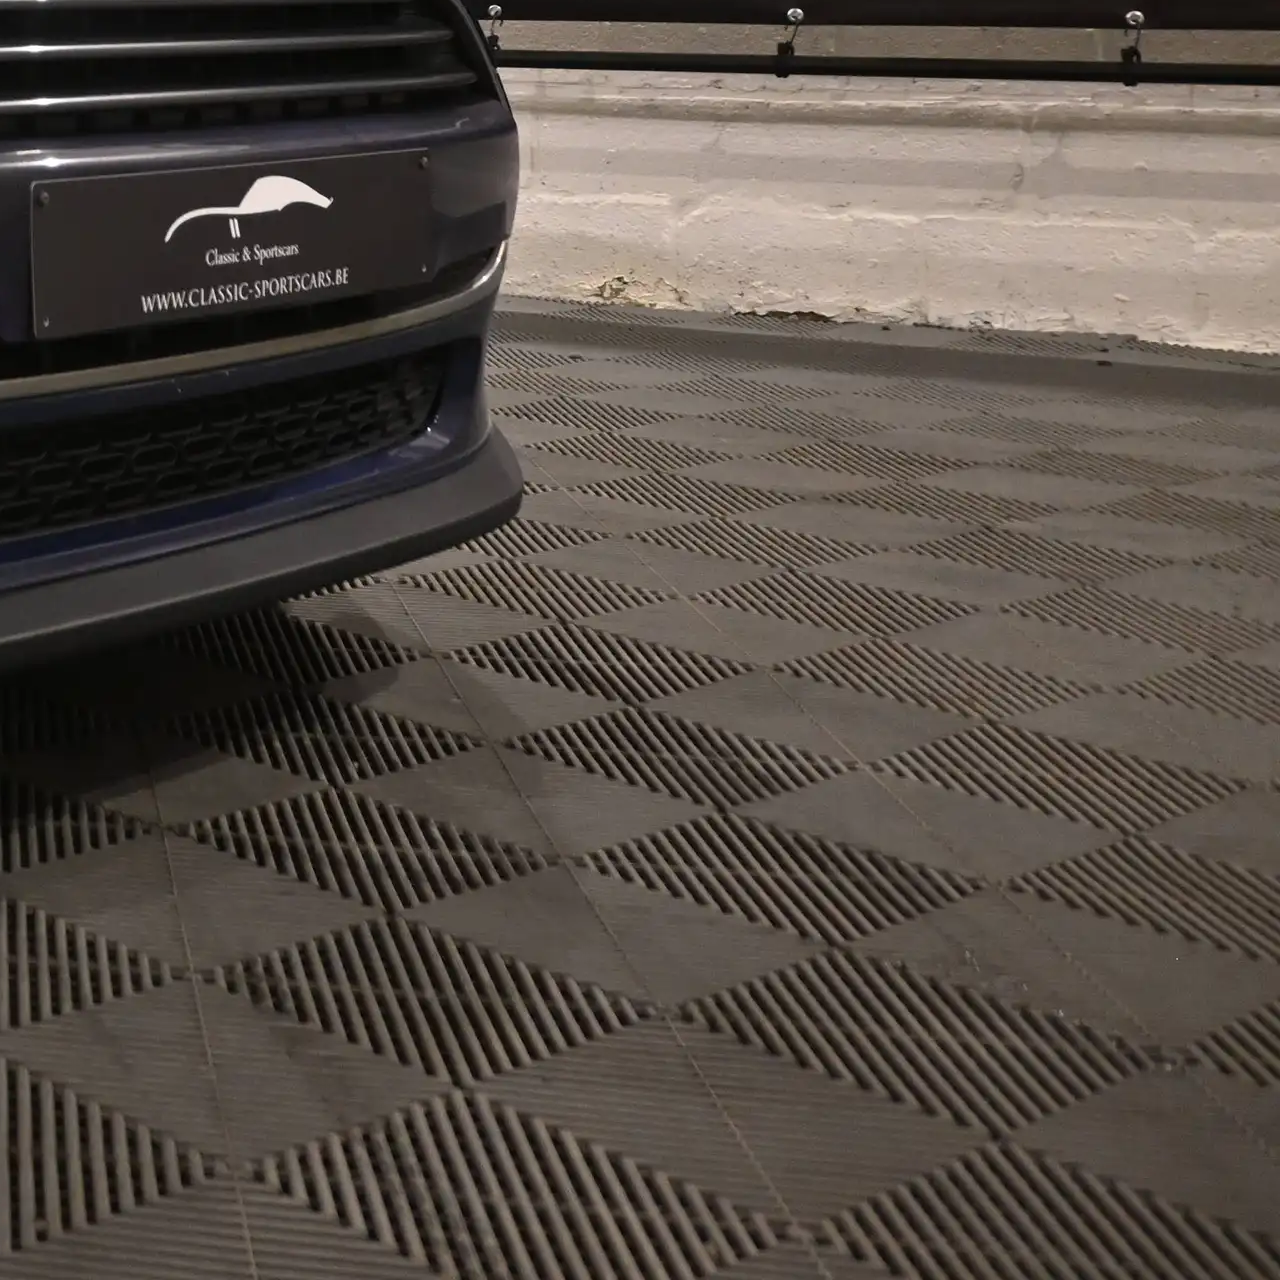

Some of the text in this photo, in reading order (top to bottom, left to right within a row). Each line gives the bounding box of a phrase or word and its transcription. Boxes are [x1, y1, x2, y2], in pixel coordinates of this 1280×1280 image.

[205, 244, 299, 266] Classic & Sportscars
[141, 267, 349, 313] WWW.CLASSIC-SPORTSCARS.BE
